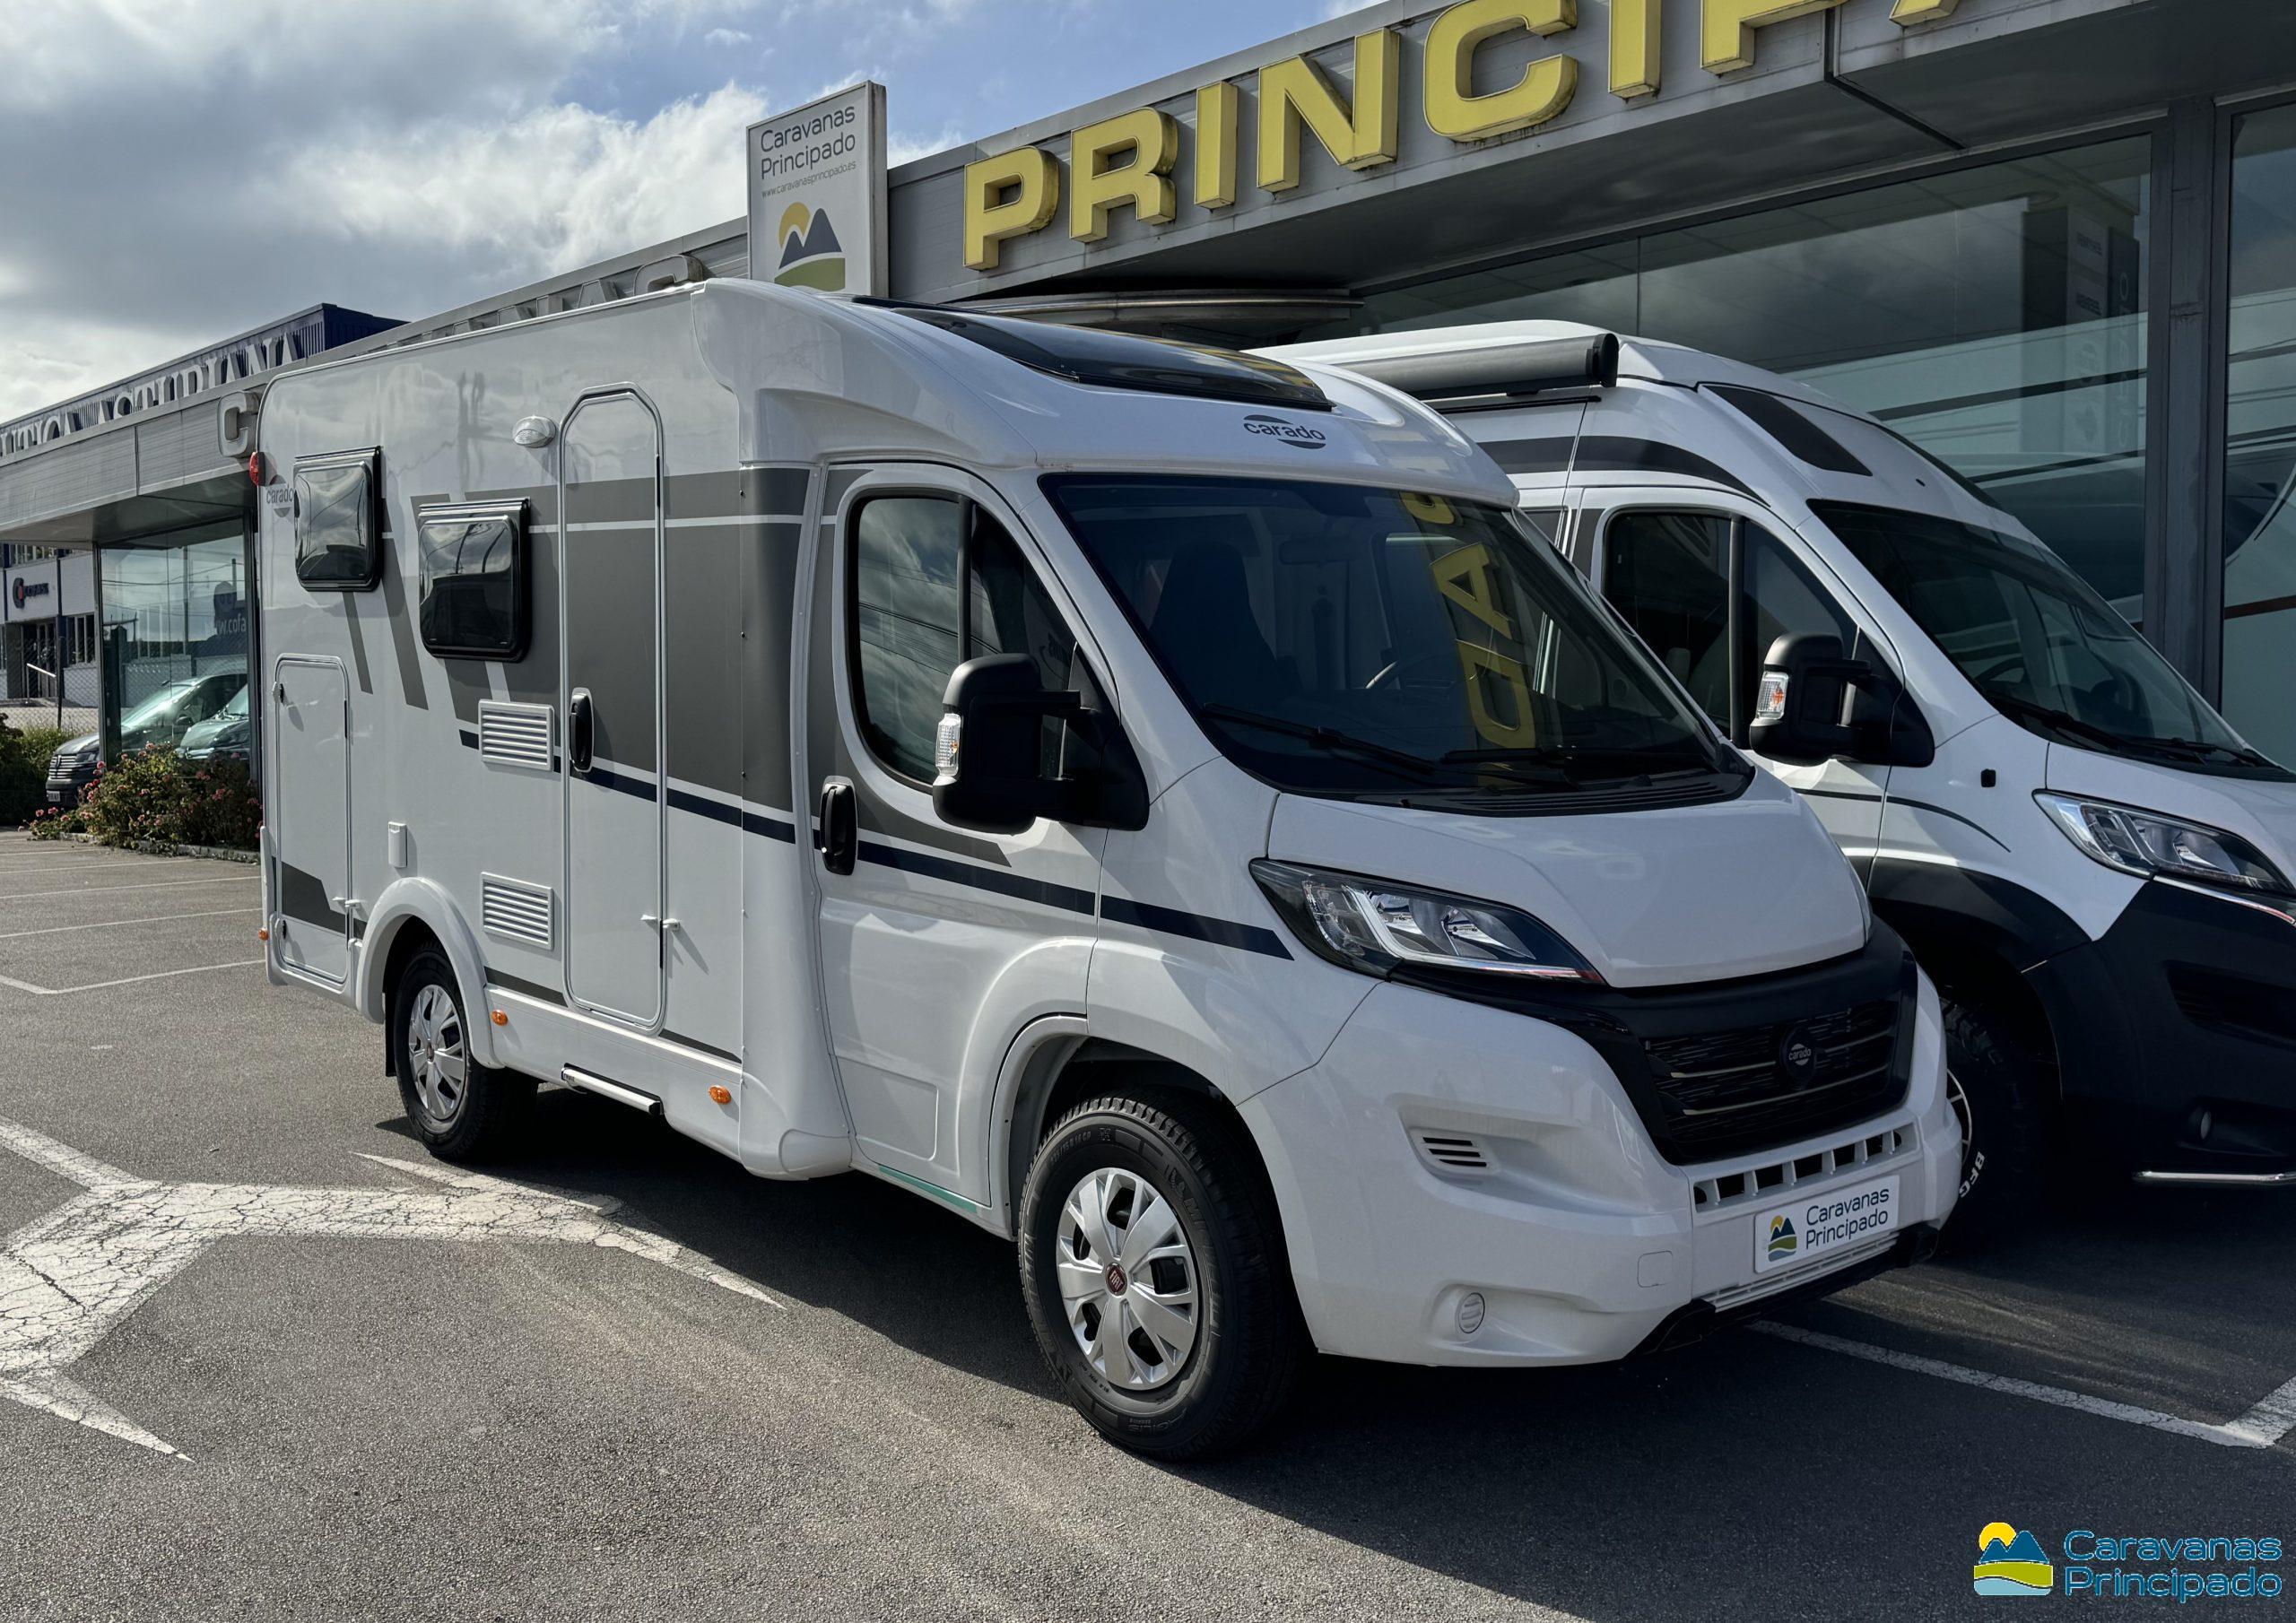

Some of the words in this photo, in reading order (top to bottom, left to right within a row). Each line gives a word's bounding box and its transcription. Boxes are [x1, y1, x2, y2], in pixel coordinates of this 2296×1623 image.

[760, 106, 856, 152] Caravanas
[963, 0, 1959, 272] PRINCIP
[761, 132, 856, 180] Principado
[1243, 422, 1326, 440] carado
[1788, 1046, 1812, 1061] carado
[1805, 1188, 1890, 1226] Caravanas
[1805, 1208, 1889, 1250] Principado
[1109, 1269, 1124, 1290] FIAT
